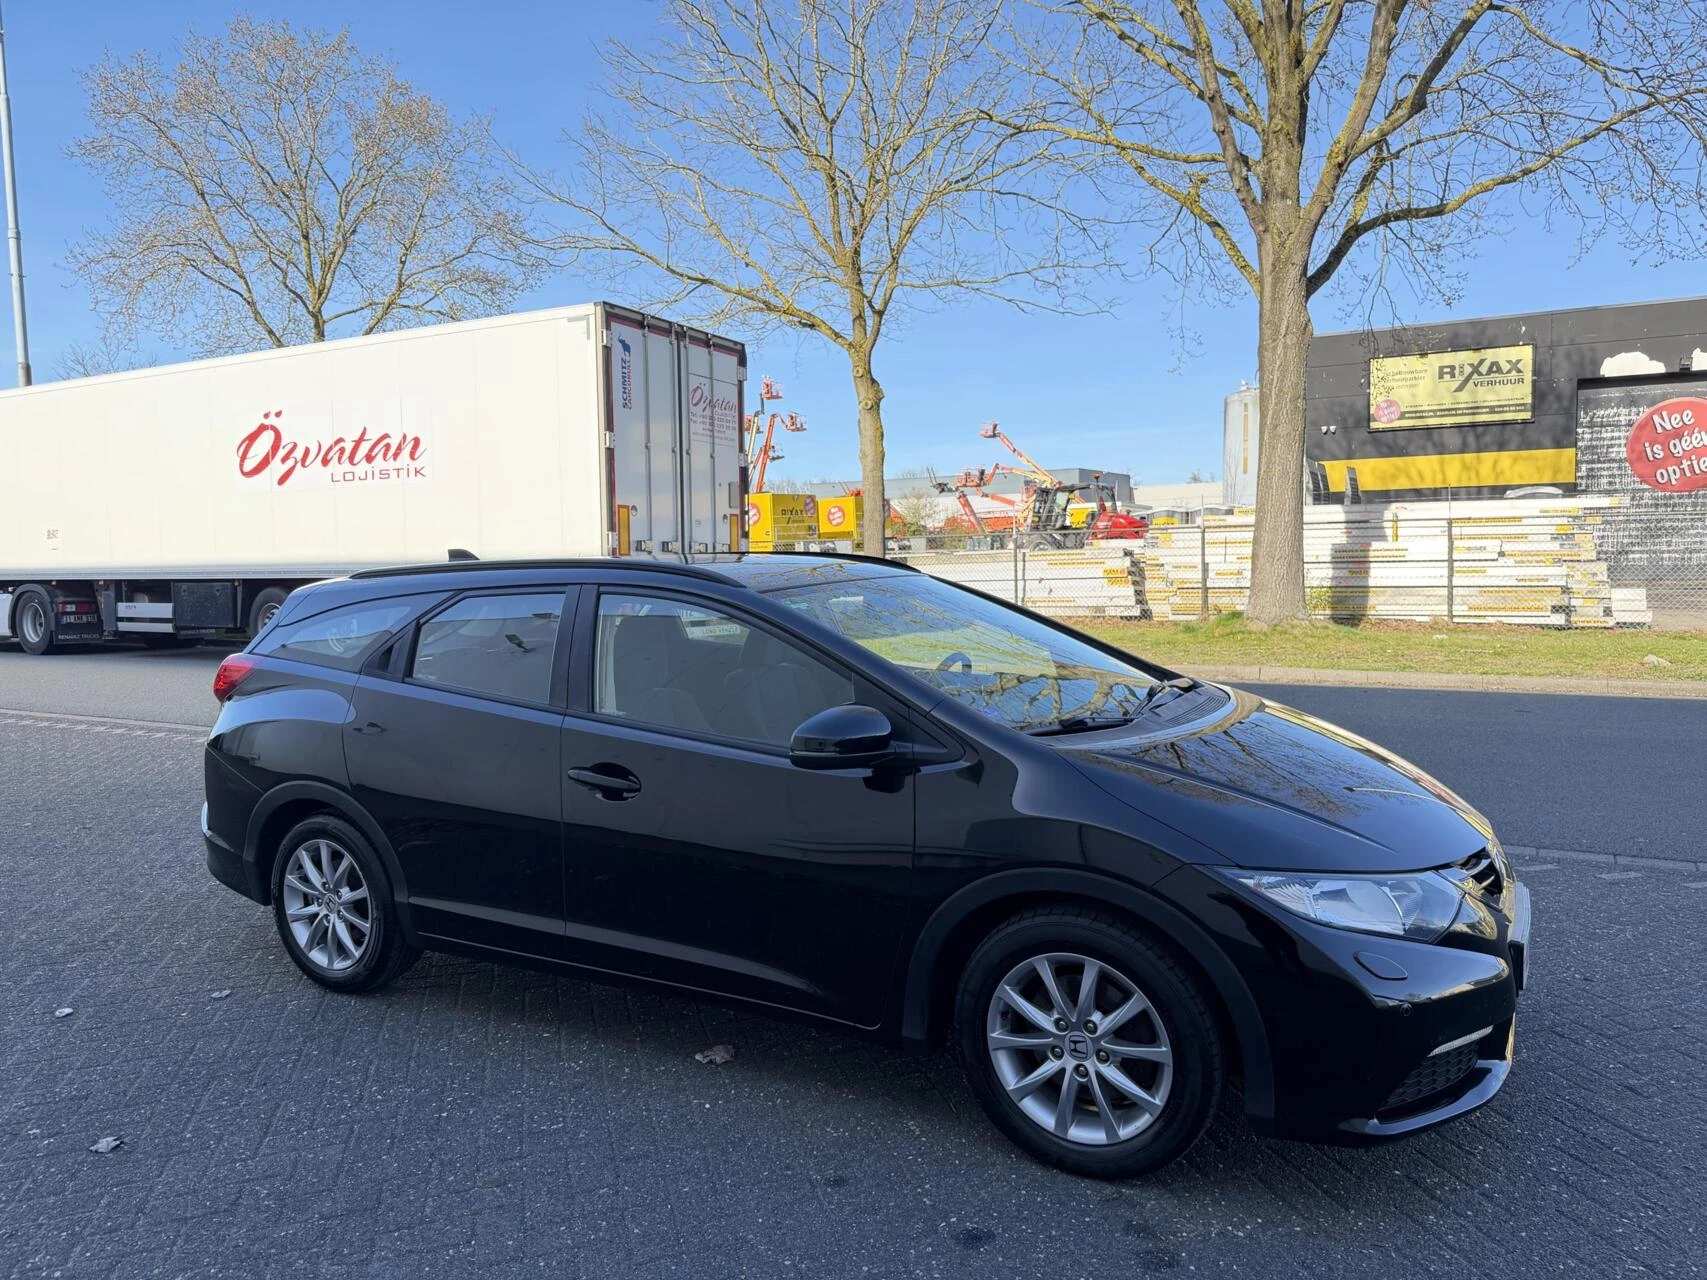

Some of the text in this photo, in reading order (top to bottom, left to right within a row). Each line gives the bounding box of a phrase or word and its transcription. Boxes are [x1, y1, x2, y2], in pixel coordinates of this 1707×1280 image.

[1473, 377, 1525, 388] VERHUUR
[1652, 409, 1696, 434] Nee
[236, 410, 428, 486] Özvatan
[1644, 441, 1665, 461] is
